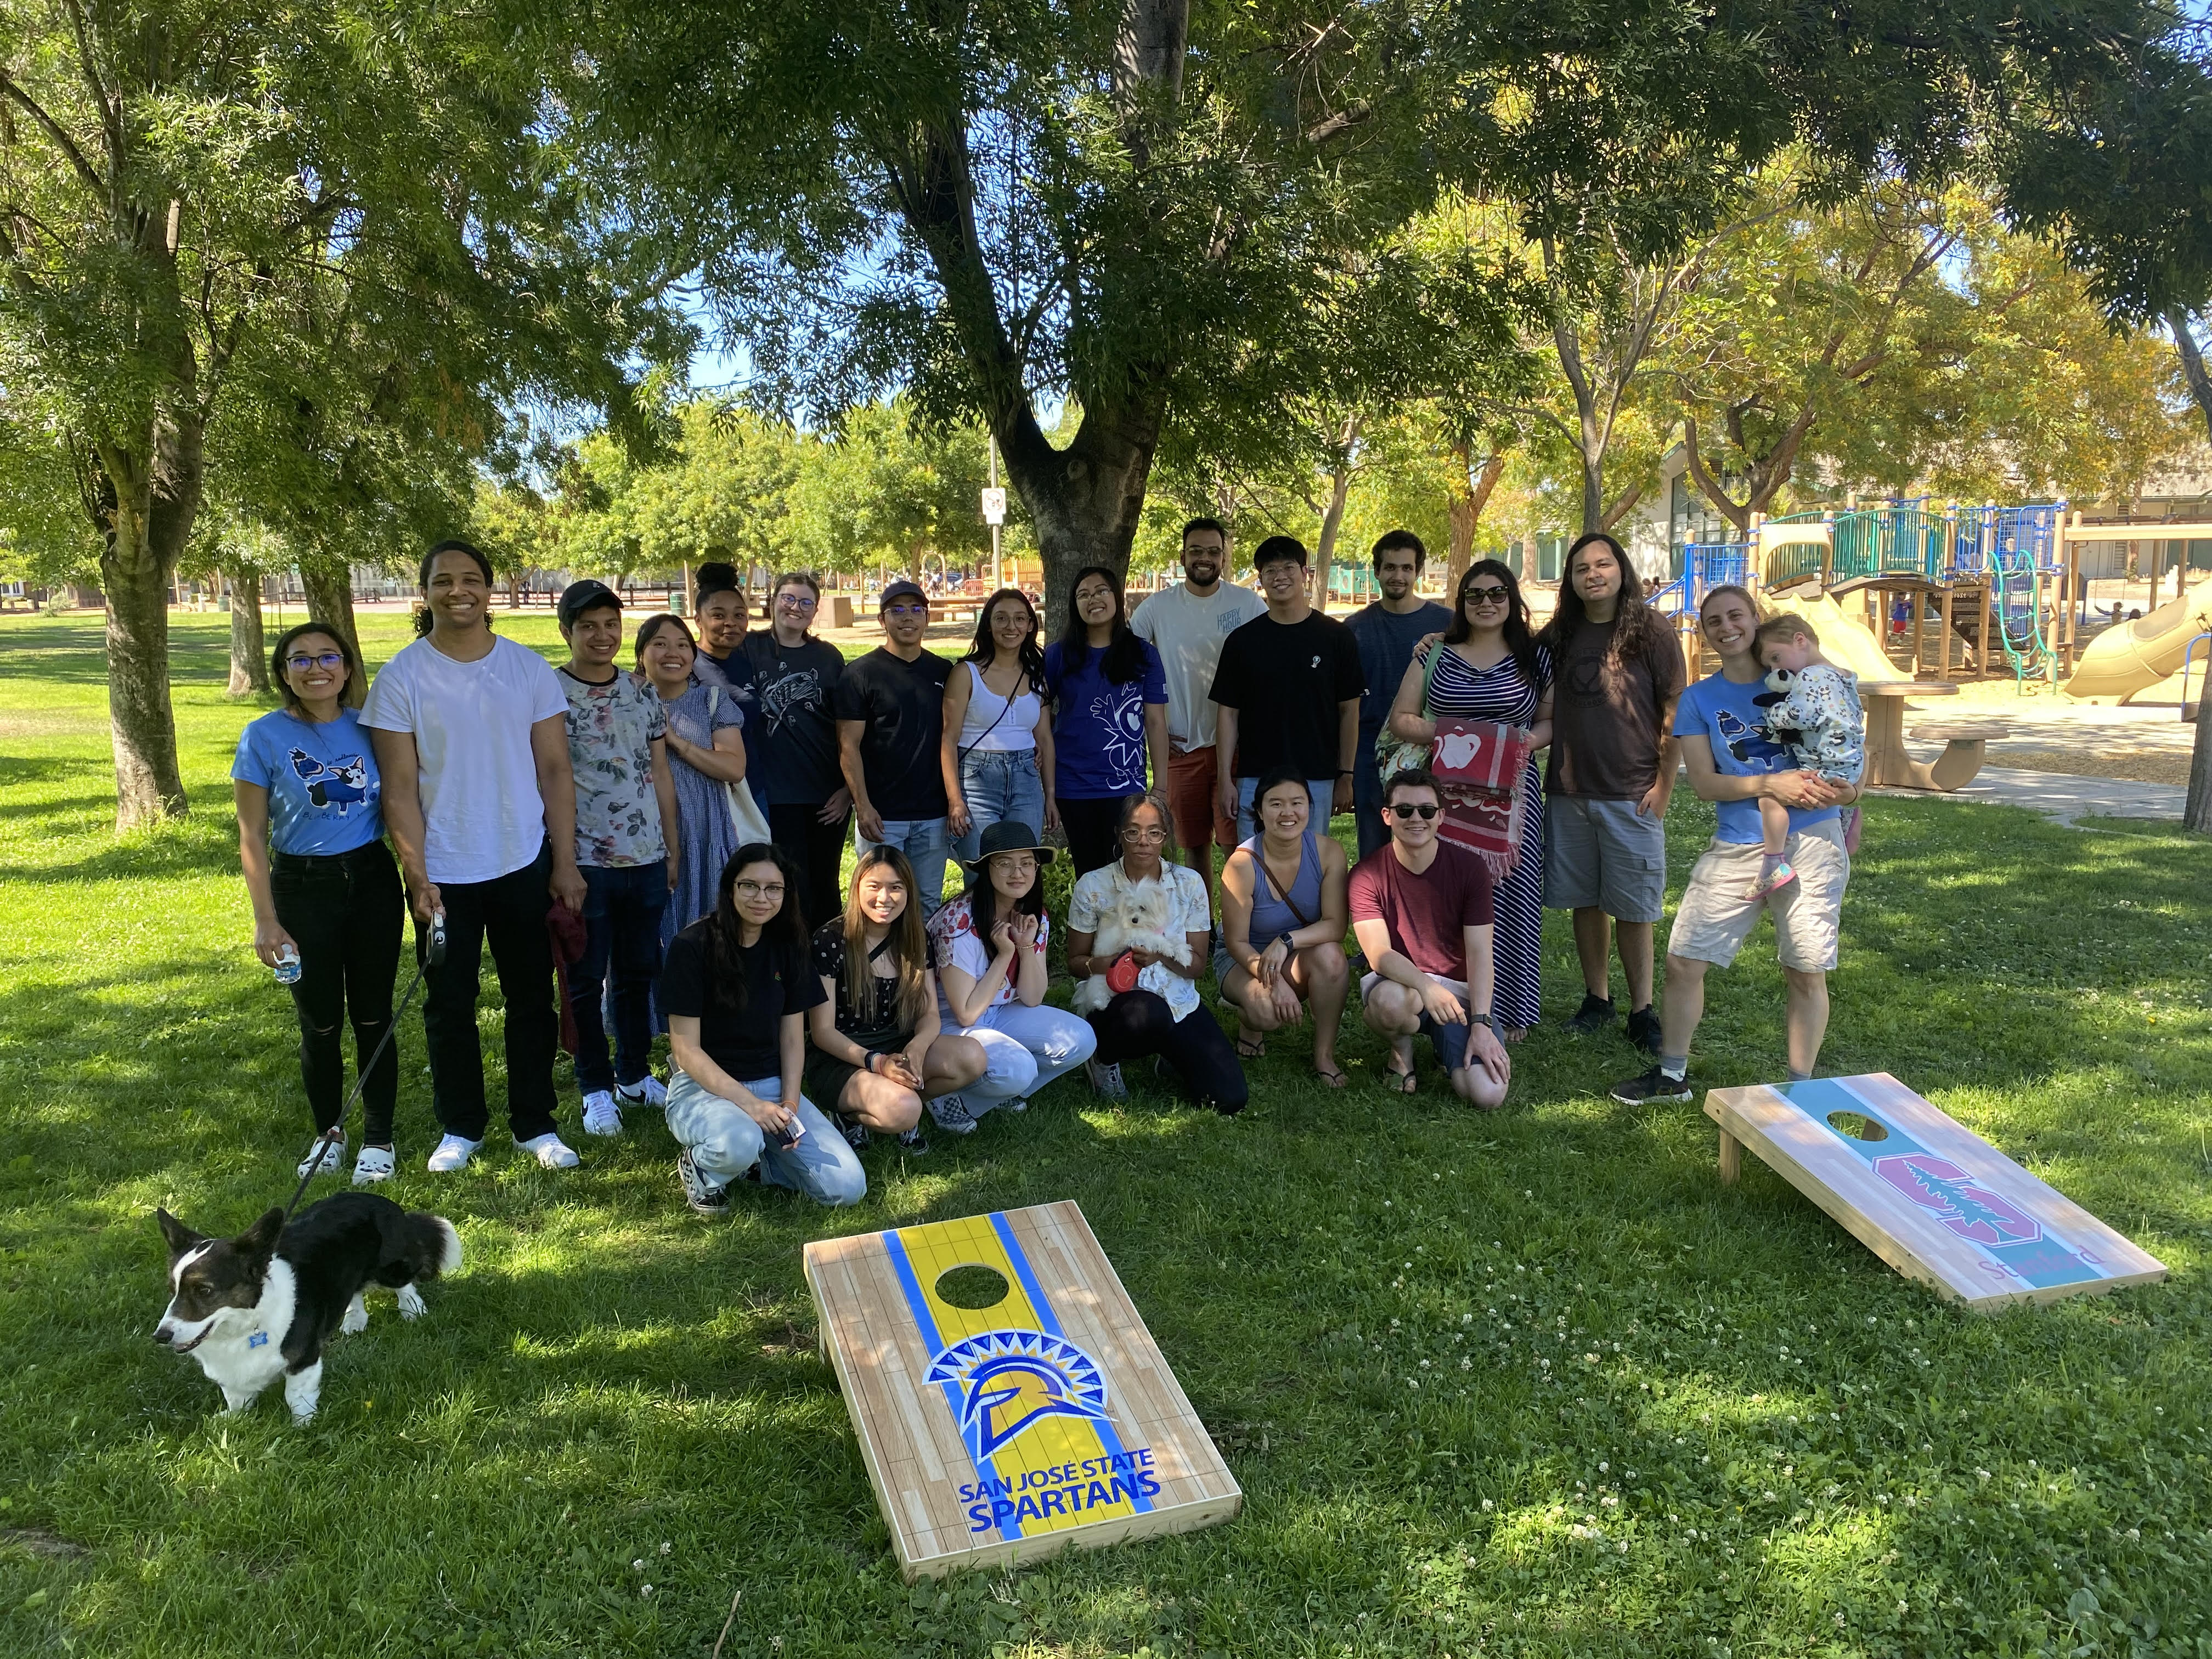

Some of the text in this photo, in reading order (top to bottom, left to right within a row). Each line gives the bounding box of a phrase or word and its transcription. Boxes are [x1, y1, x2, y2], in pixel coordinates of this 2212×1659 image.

[1217, 607, 1241, 630] HAPPY
[1223, 617, 1241, 633] HOUR
[302, 811, 350, 821] BLBERRY
[959, 1448, 1155, 1503] SAN JOSÉ STATE
[968, 1470, 1161, 1532] SPARTANS
